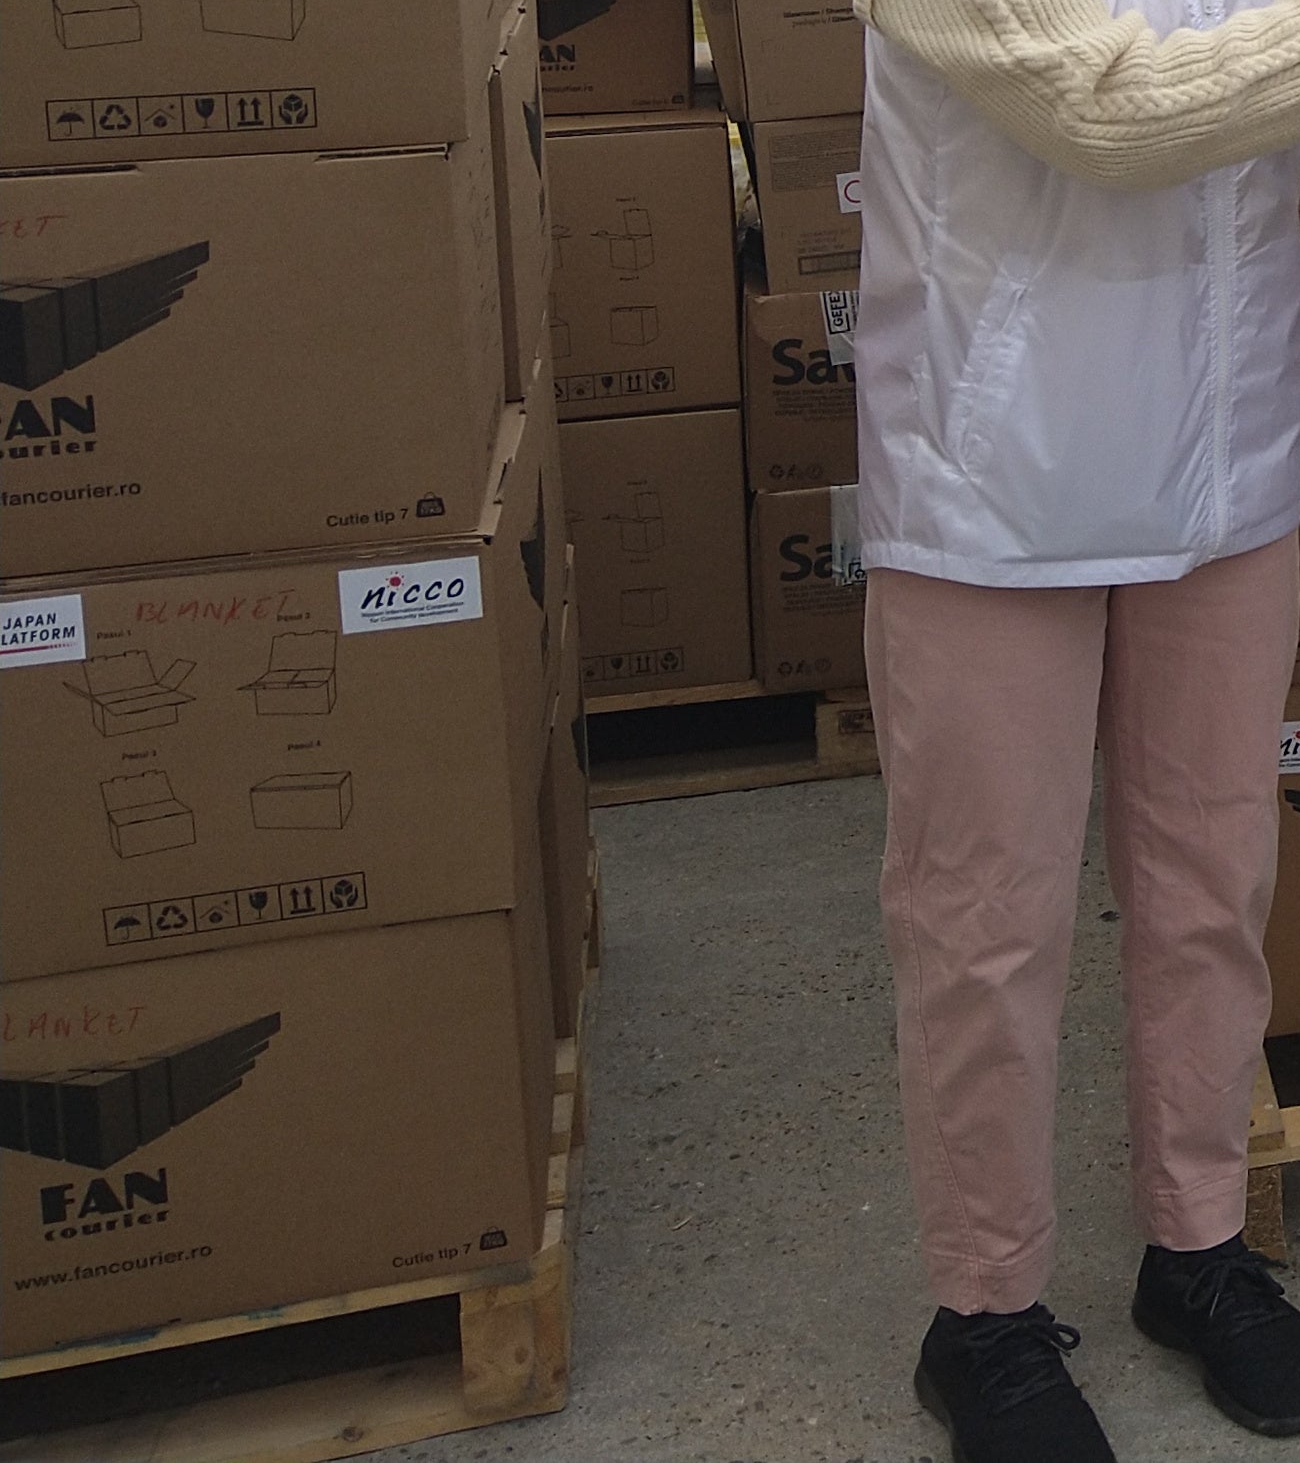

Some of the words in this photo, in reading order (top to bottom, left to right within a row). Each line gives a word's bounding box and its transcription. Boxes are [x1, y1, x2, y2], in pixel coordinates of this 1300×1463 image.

[539, 44, 575, 63] AN
[0, 394, 97, 441] AN
[0, 438, 97, 460] ourier
[1, 481, 142, 507] fancourier.ro
[326, 512, 370, 527] Cutie
[374, 509, 396, 525] tip
[400, 508, 409, 520] 7
[135, 589, 296, 626] BLANKET
[361, 576, 465, 610] nicco
[0, 625, 76, 646] LATFORM
[3, 613, 57, 631] JAPAN
[3, 1006, 145, 1041] LANKET
[40, 1167, 169, 1225] FAN
[44, 1208, 171, 1242] courier
[15, 1245, 213, 1291] www.fancourier.ro
[392, 1252, 435, 1268] Cutie
[438, 1247, 459, 1260] tip
[463, 1242, 472, 1255] 7
